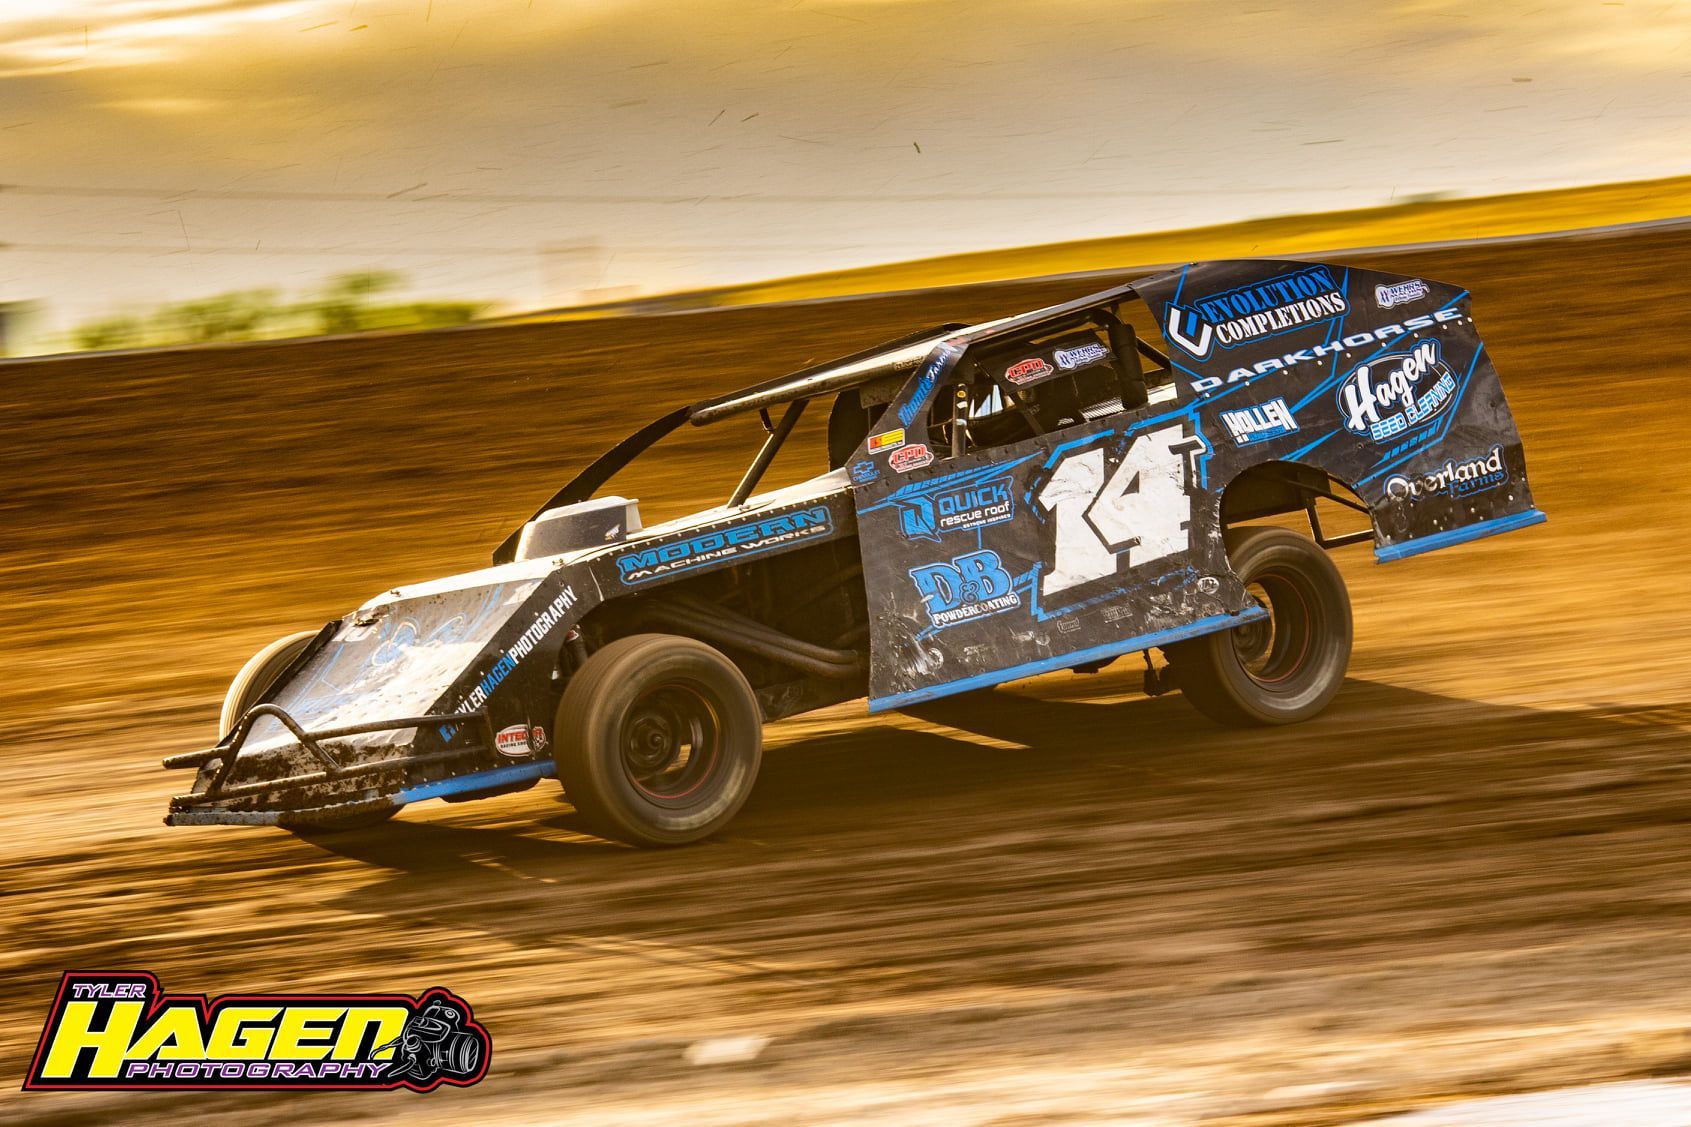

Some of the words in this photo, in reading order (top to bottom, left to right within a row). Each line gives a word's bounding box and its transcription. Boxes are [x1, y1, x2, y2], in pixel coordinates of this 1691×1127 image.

[1216, 292, 1346, 344] COMPLETIONS
[1190, 307, 1463, 393] DARKHORSE
[1344, 343, 1436, 431] Hagen
[1370, 412, 1407, 440] SEED
[1404, 371, 1456, 426] CLEANING
[1222, 399, 1298, 444] HOLLEN
[938, 483, 1008, 516] QUICK
[1387, 447, 1503, 501] Overland
[620, 509, 826, 573] MODERN
[940, 509, 982, 527] rescue
[984, 501, 1010, 516] roof
[628, 547, 737, 581] MACHINE
[741, 525, 826, 549] WORKS
[932, 594, 1018, 625] POWDERCOATING
